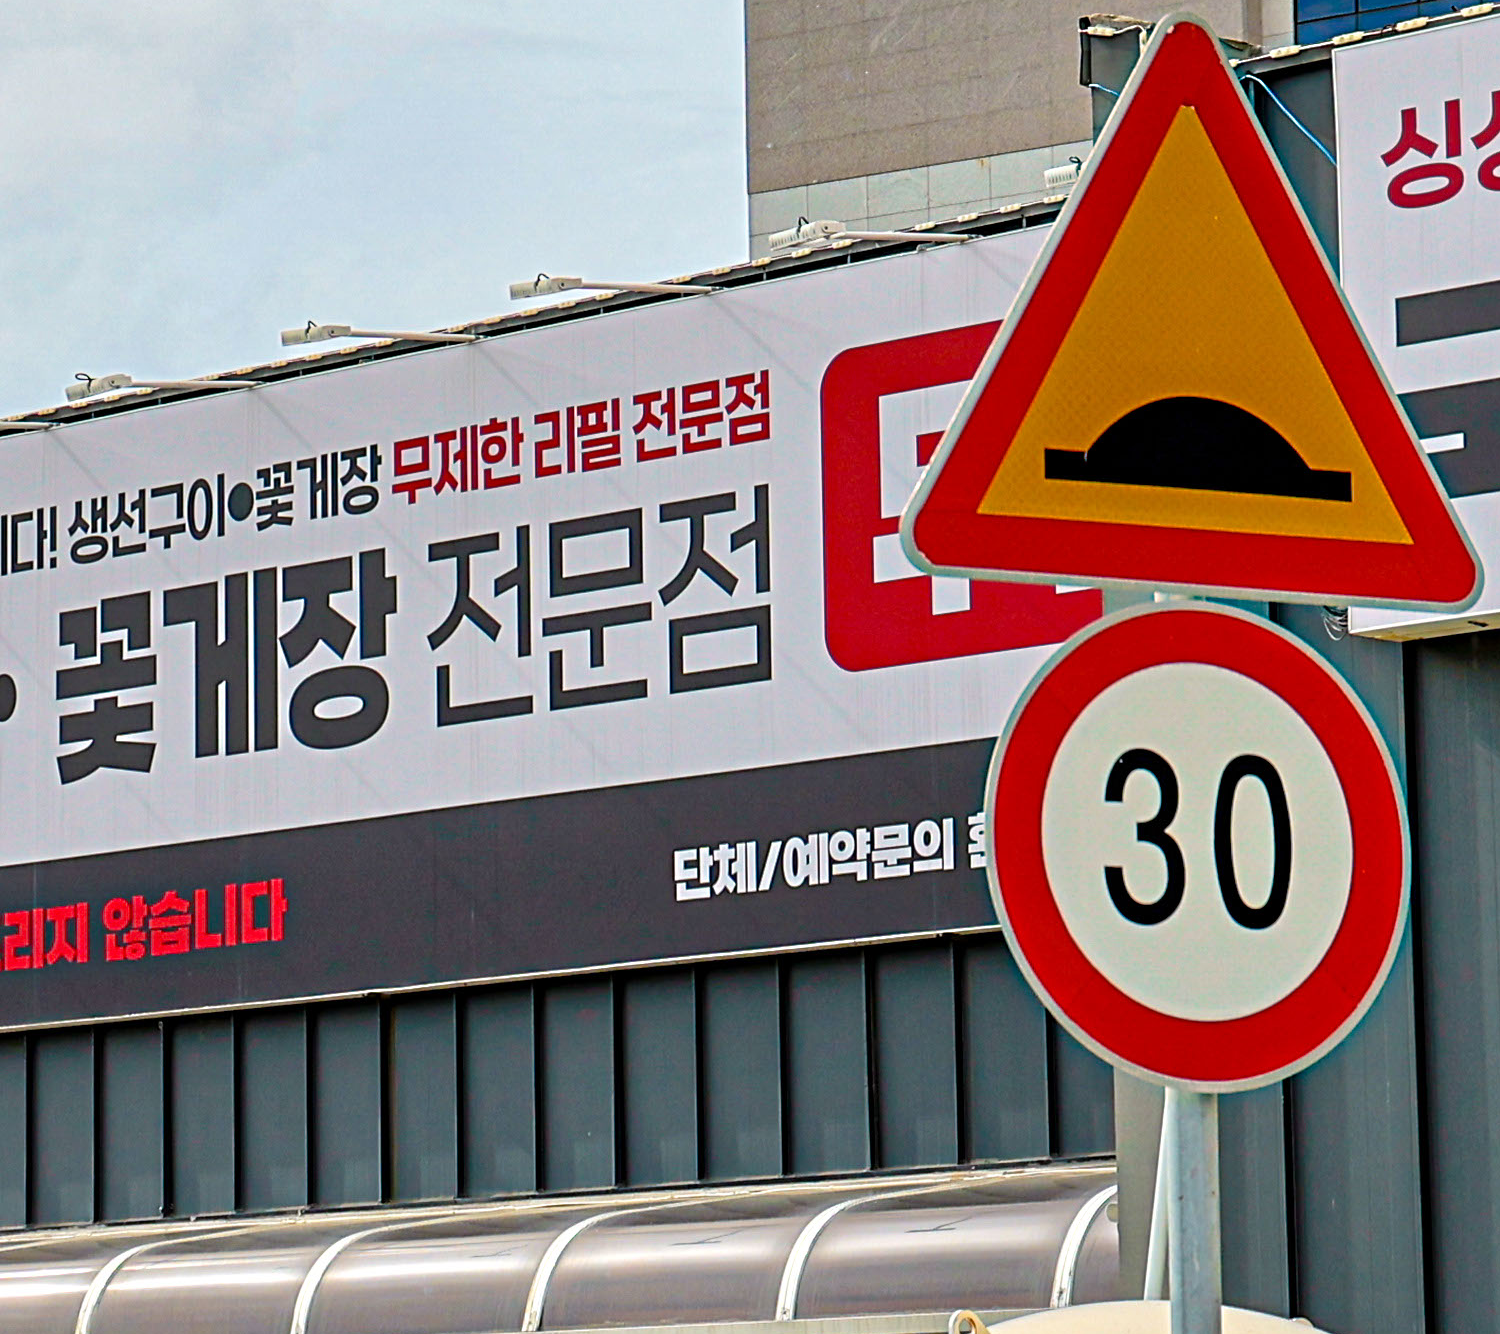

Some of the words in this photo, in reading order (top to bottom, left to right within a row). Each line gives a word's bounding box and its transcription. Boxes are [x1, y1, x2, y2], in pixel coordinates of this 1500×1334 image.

[391, 414, 525, 506] 무제한
[534, 406, 623, 476] 리필
[632, 369, 772, 463] 전문점
[55, 546, 399, 785] 꽃게장
[427, 483, 772, 728] 전문점
[673, 817, 955, 903] 단체/예약문의
[1102, 747, 1292, 931] 30
[103, 878, 288, 961] 않습니다
